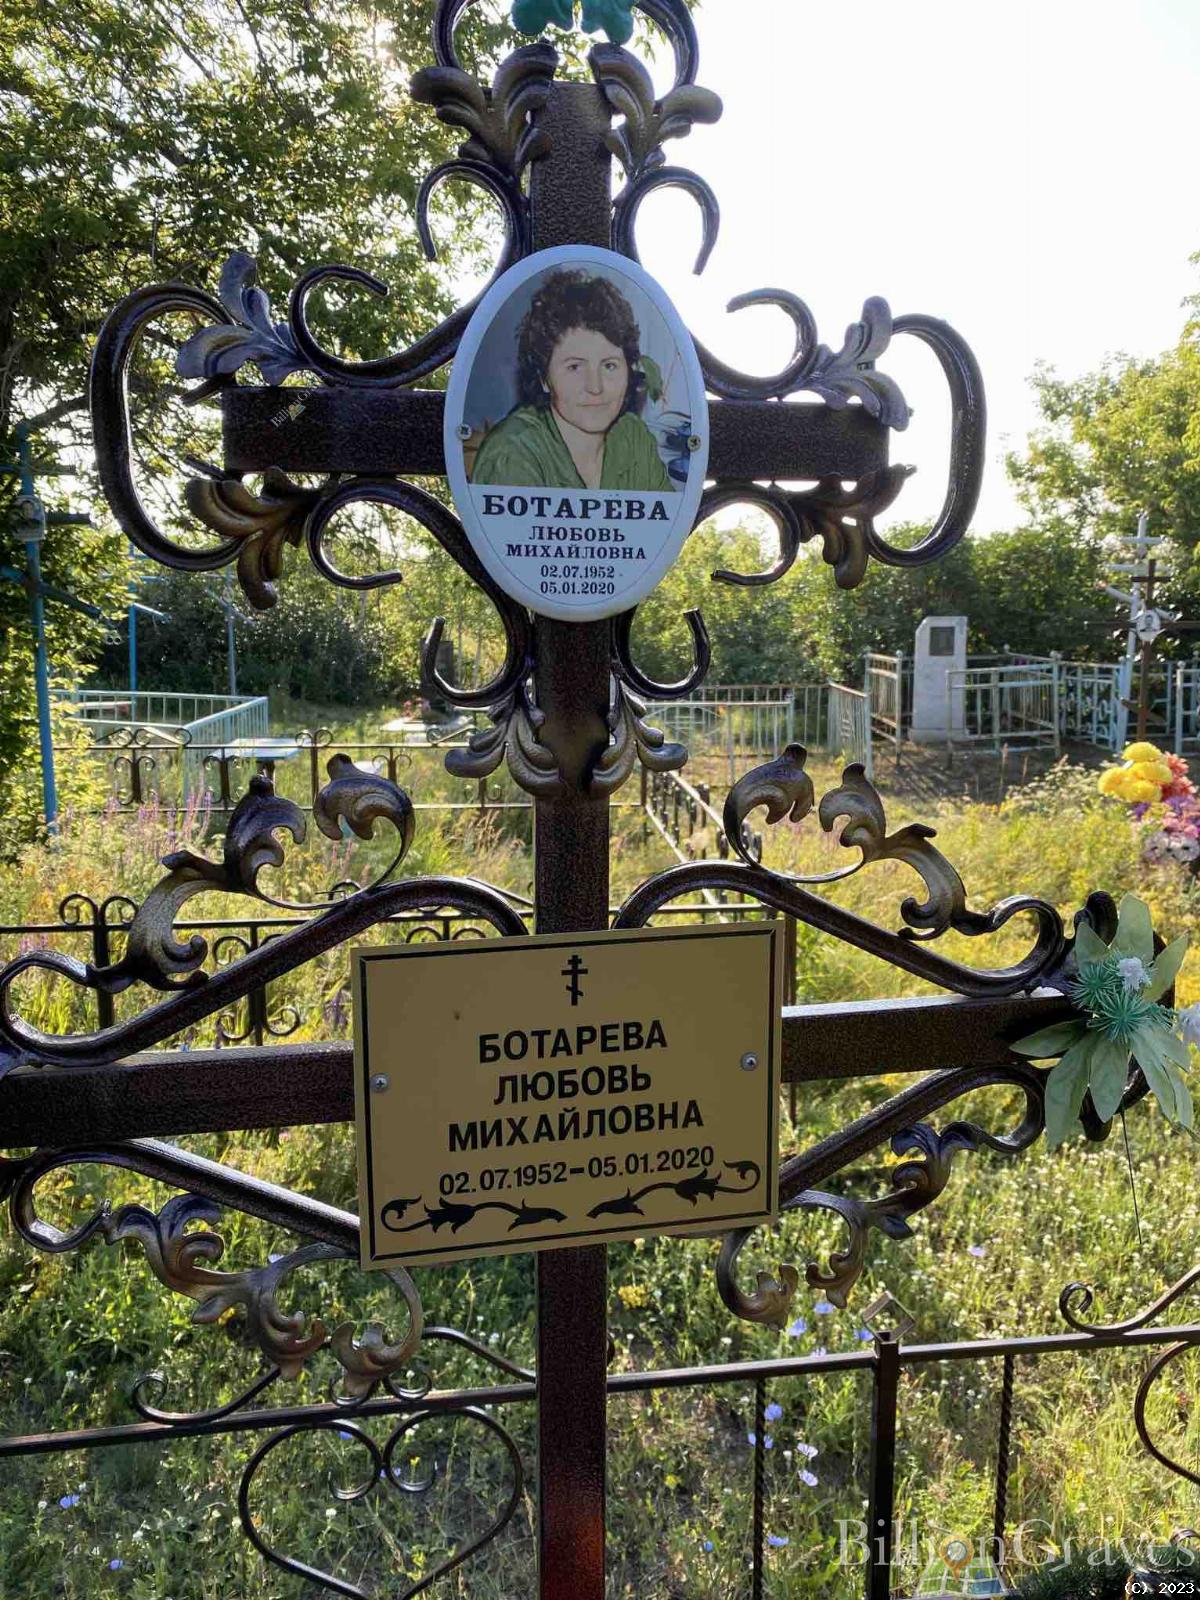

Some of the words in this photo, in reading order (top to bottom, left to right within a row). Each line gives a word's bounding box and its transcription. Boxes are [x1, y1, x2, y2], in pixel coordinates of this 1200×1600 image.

[528, 526, 626, 542] ЛЮБОВЬ
[506, 543, 647, 560] МИХАЙЛОВНА
[540, 565, 615, 579] 02.07.1952
[540, 582, 615, 595] 05.01.2020
[478, 1019, 668, 1064] БОТАРЕВА
[493, 1064, 652, 1106] ЛЮБОВЬ
[448, 1100, 704, 1153] МИХАЙЛОВНА
